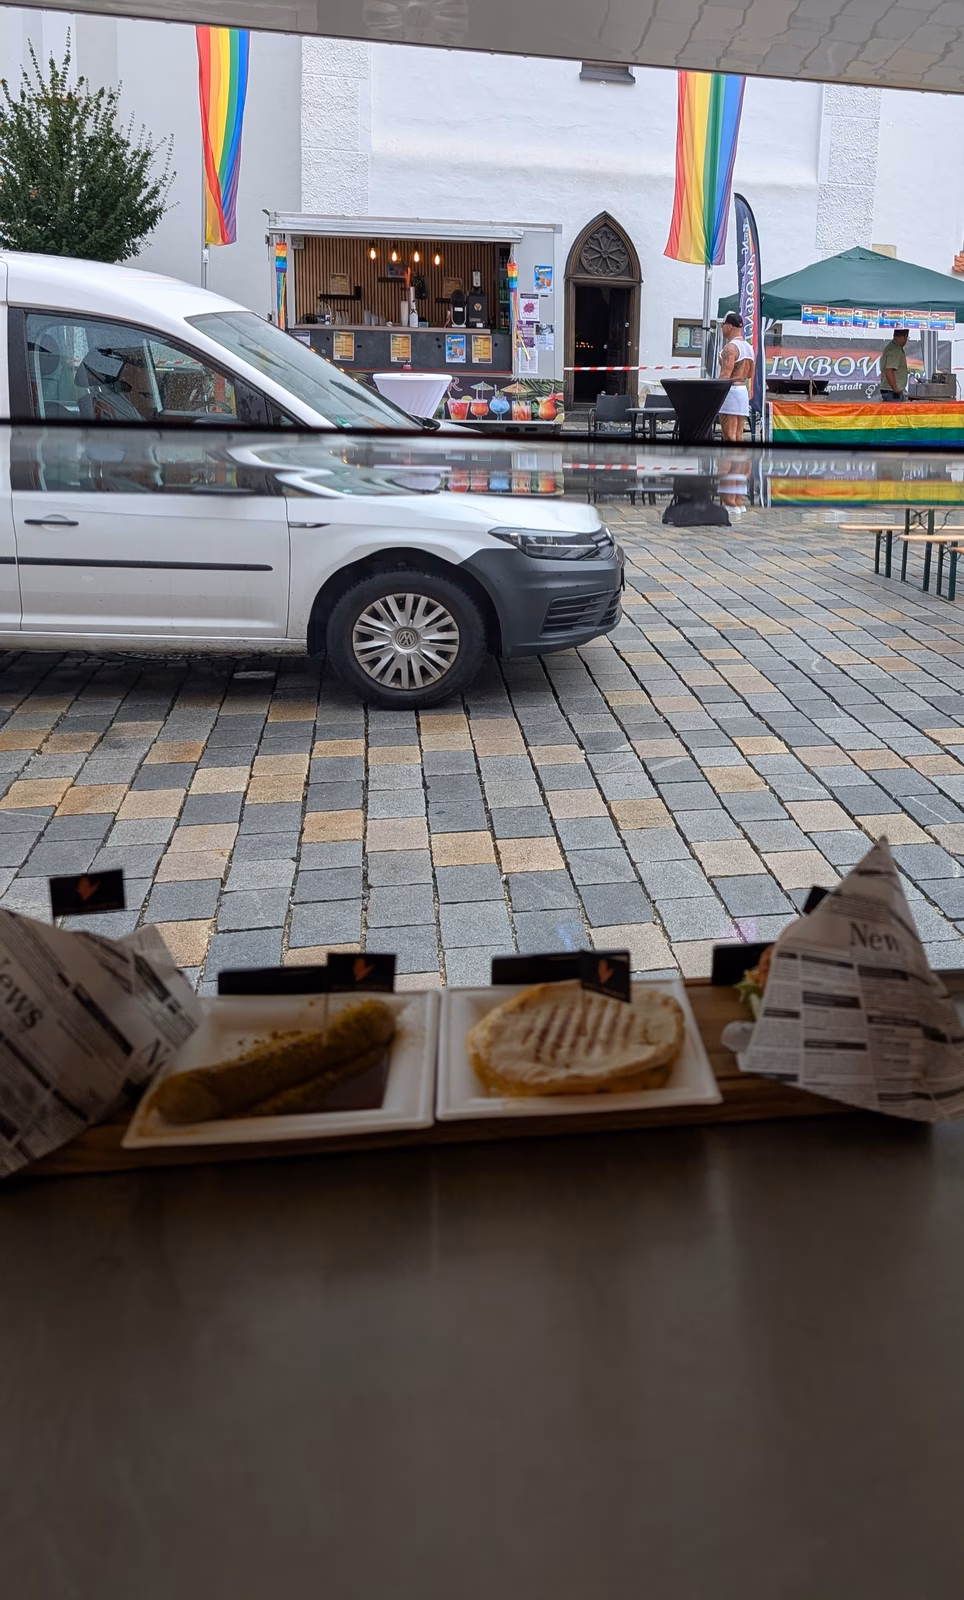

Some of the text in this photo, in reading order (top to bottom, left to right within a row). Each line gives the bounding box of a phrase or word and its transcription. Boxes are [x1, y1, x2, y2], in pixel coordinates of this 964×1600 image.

[768, 355, 881, 378] INBOW
[824, 382, 862, 393] golstadt
[0, 958, 43, 1030] ews
